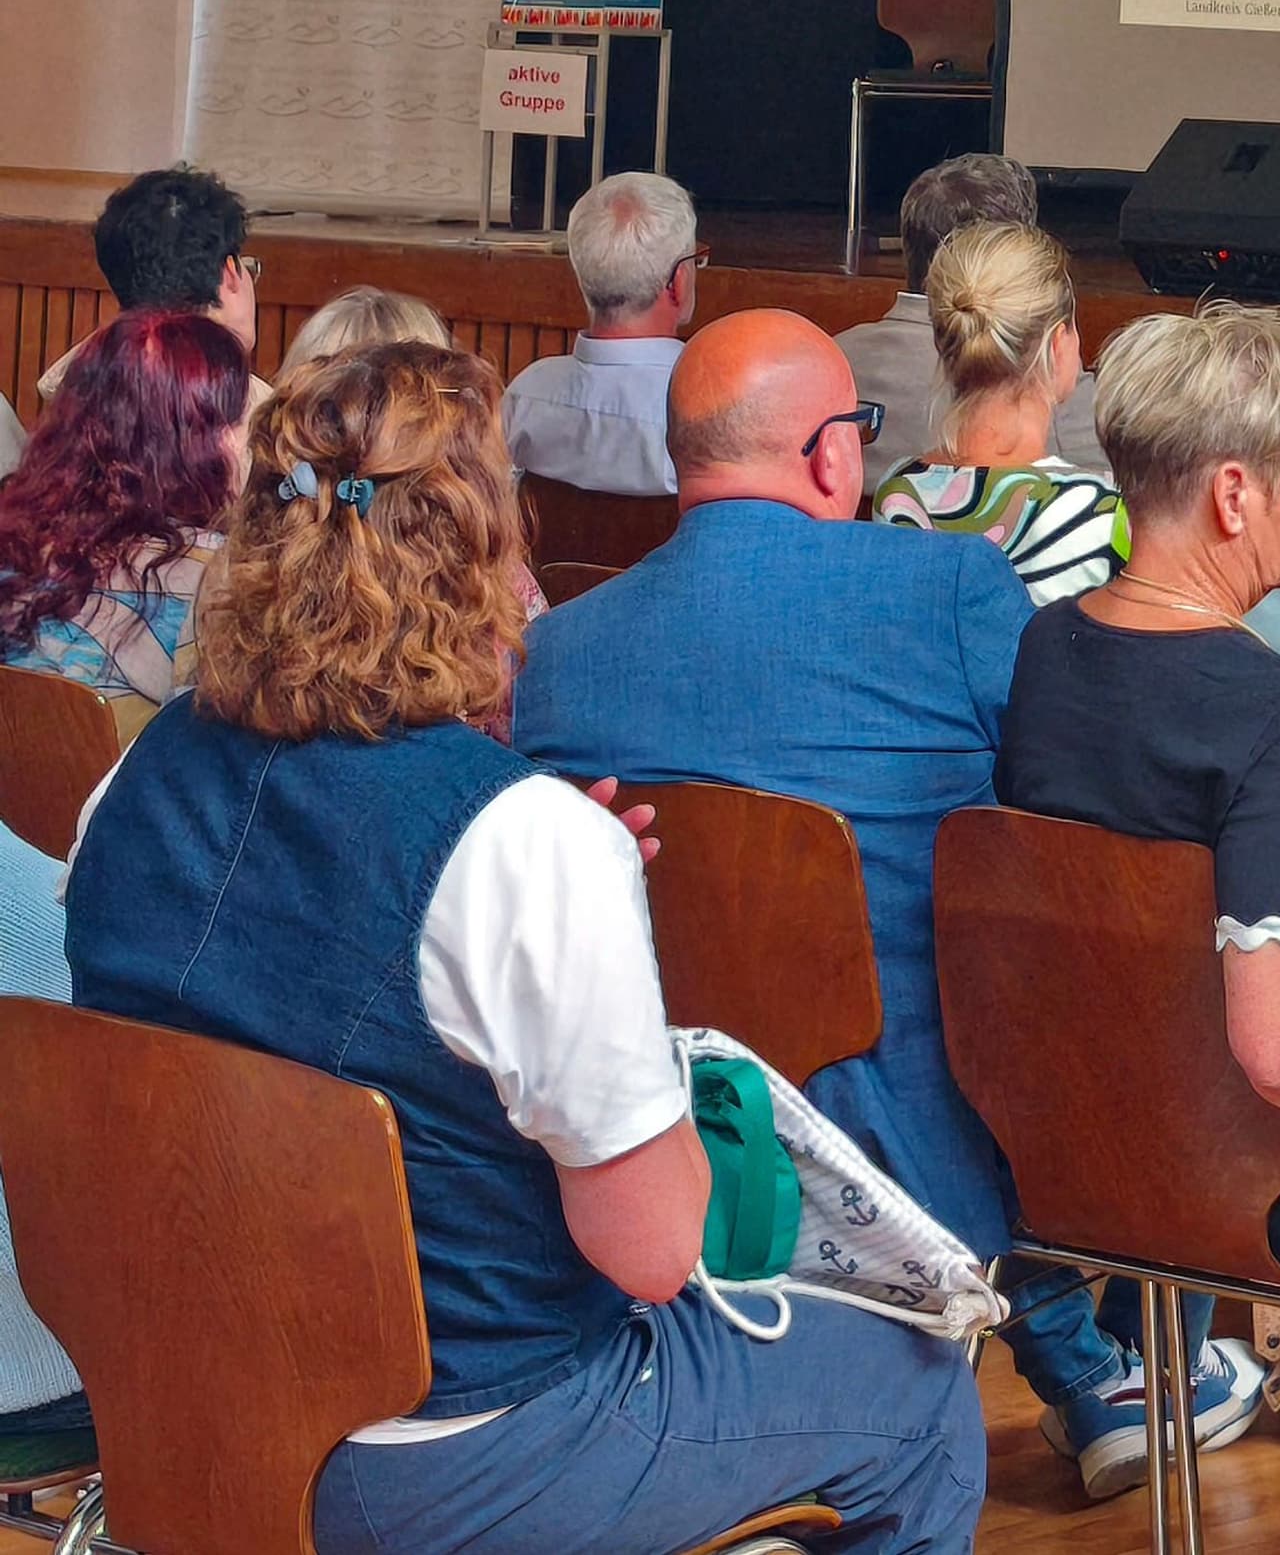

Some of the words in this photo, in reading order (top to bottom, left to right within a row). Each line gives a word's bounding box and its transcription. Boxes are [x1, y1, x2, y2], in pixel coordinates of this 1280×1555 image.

[1185, 0, 1242, 16] Landkreis
[508, 65, 561, 85] aktive
[499, 90, 566, 115] Gruppe
